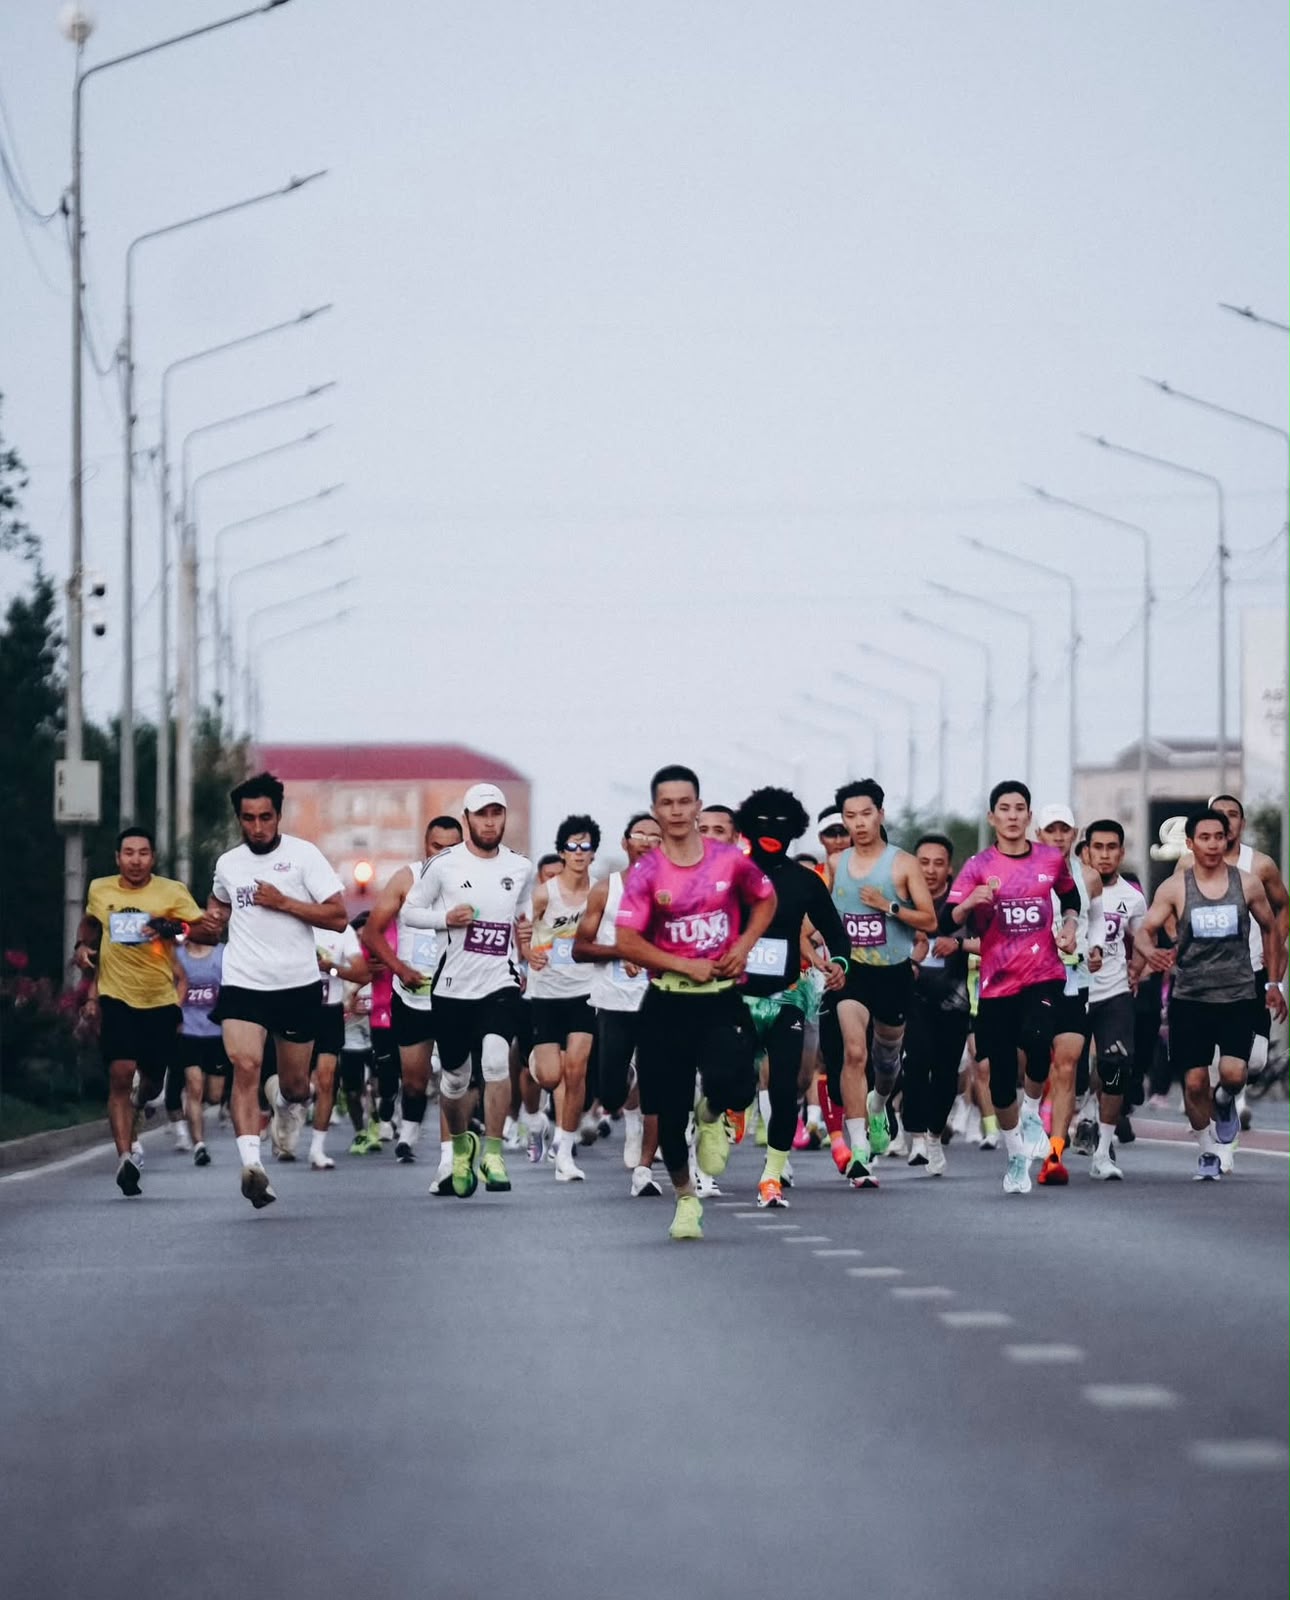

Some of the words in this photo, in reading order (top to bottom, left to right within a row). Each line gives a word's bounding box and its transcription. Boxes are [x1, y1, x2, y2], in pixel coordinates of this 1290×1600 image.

[1003, 906, 1040, 924] 196
[470, 927, 506, 946] 375
[846, 920, 883, 937] 059
[188, 988, 213, 1000] 276
